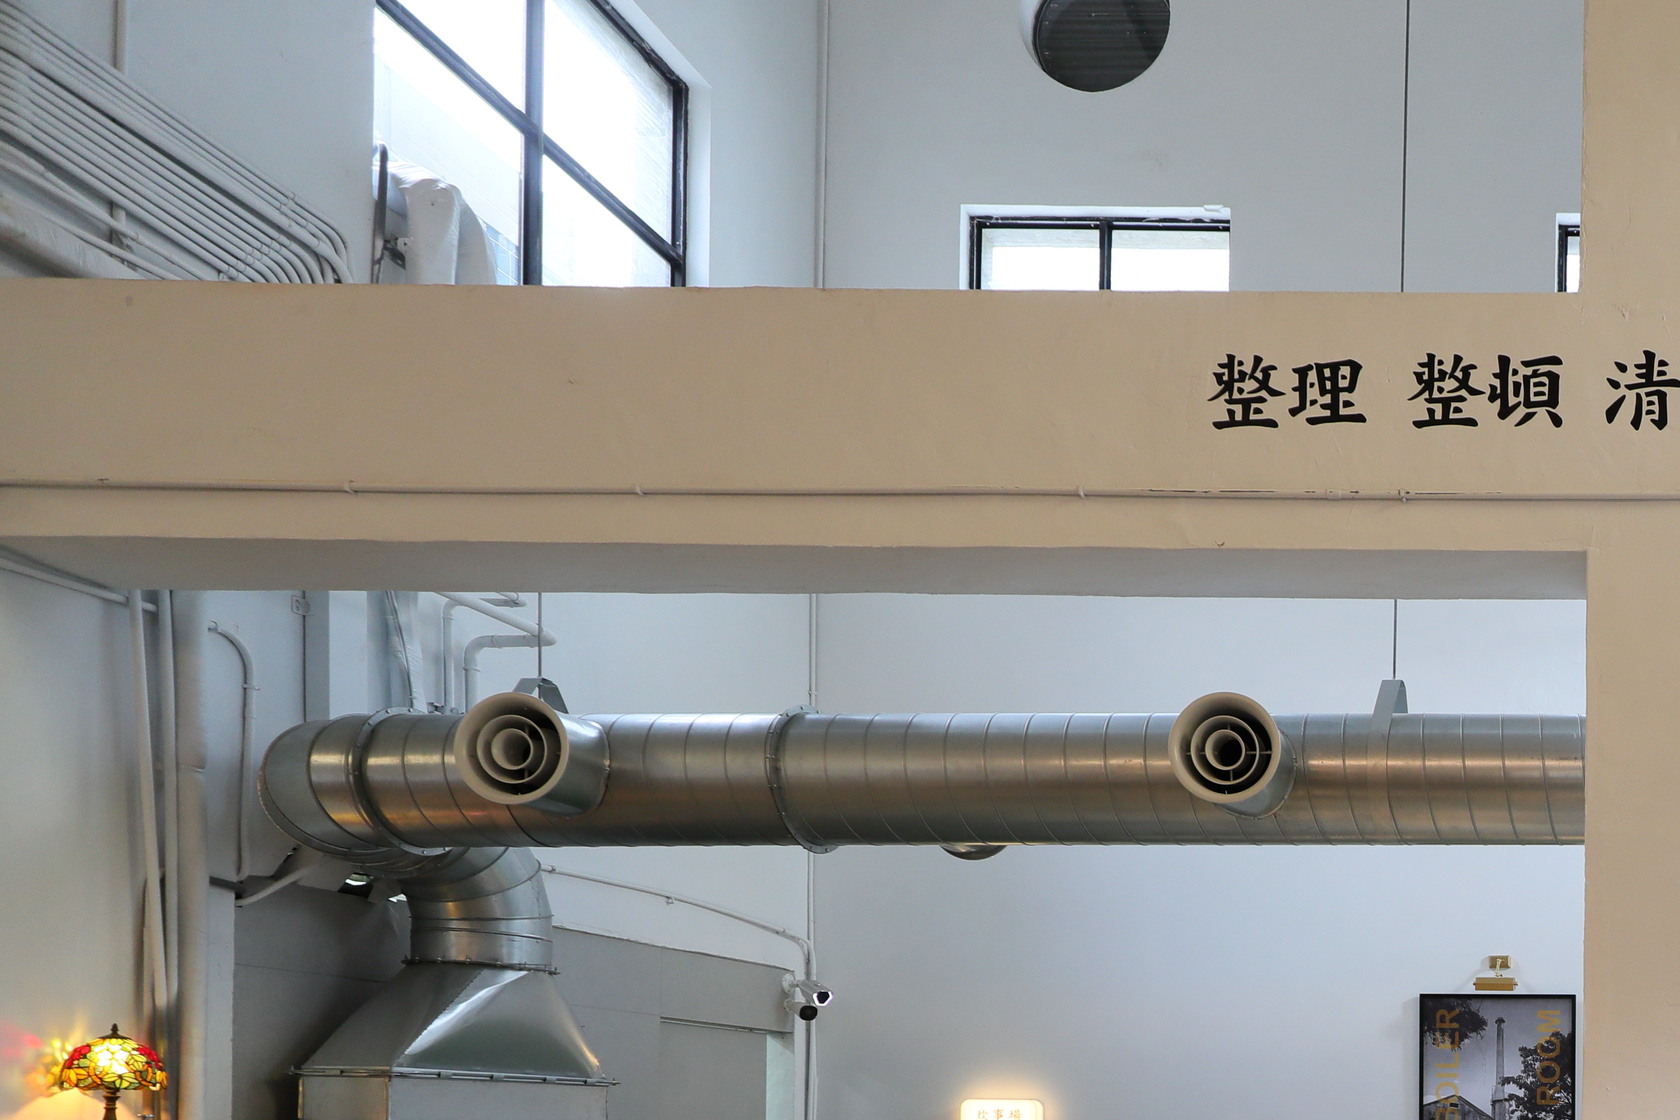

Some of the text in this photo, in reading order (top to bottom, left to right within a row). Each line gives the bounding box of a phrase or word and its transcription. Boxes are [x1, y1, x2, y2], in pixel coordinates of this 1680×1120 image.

[1208, 354, 1366, 430] 整理
[1408, 353, 1563, 429] 整頓
[1537, 1009, 1561, 1106] ROOM
